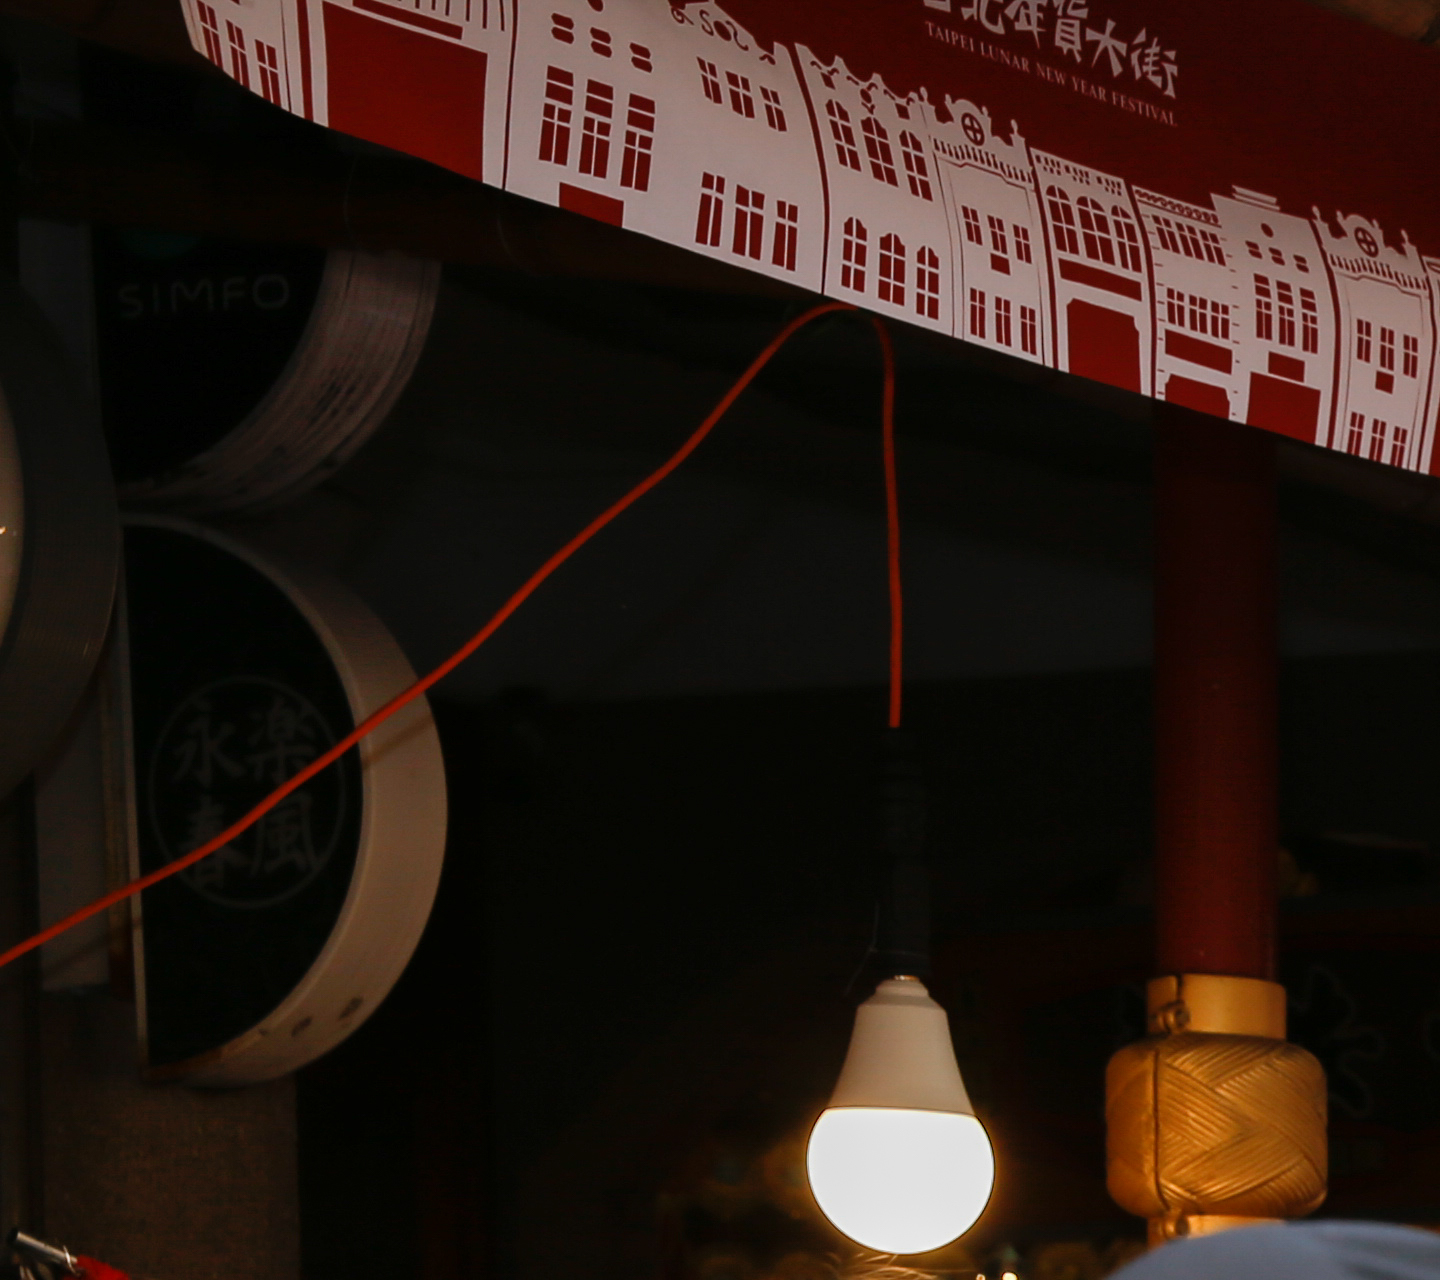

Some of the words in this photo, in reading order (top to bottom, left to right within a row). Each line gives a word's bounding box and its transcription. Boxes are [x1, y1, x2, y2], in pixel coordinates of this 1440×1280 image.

[923, 0, 1178, 99] 北年貨大街
[925, 20, 975, 53] TAIPEI
[980, 41, 1030, 73] LUNAR
[1037, 62, 1066, 86] NEW
[1072, 75, 1106, 102] YEAR
[1112, 91, 1178, 127] FESTIVAL
